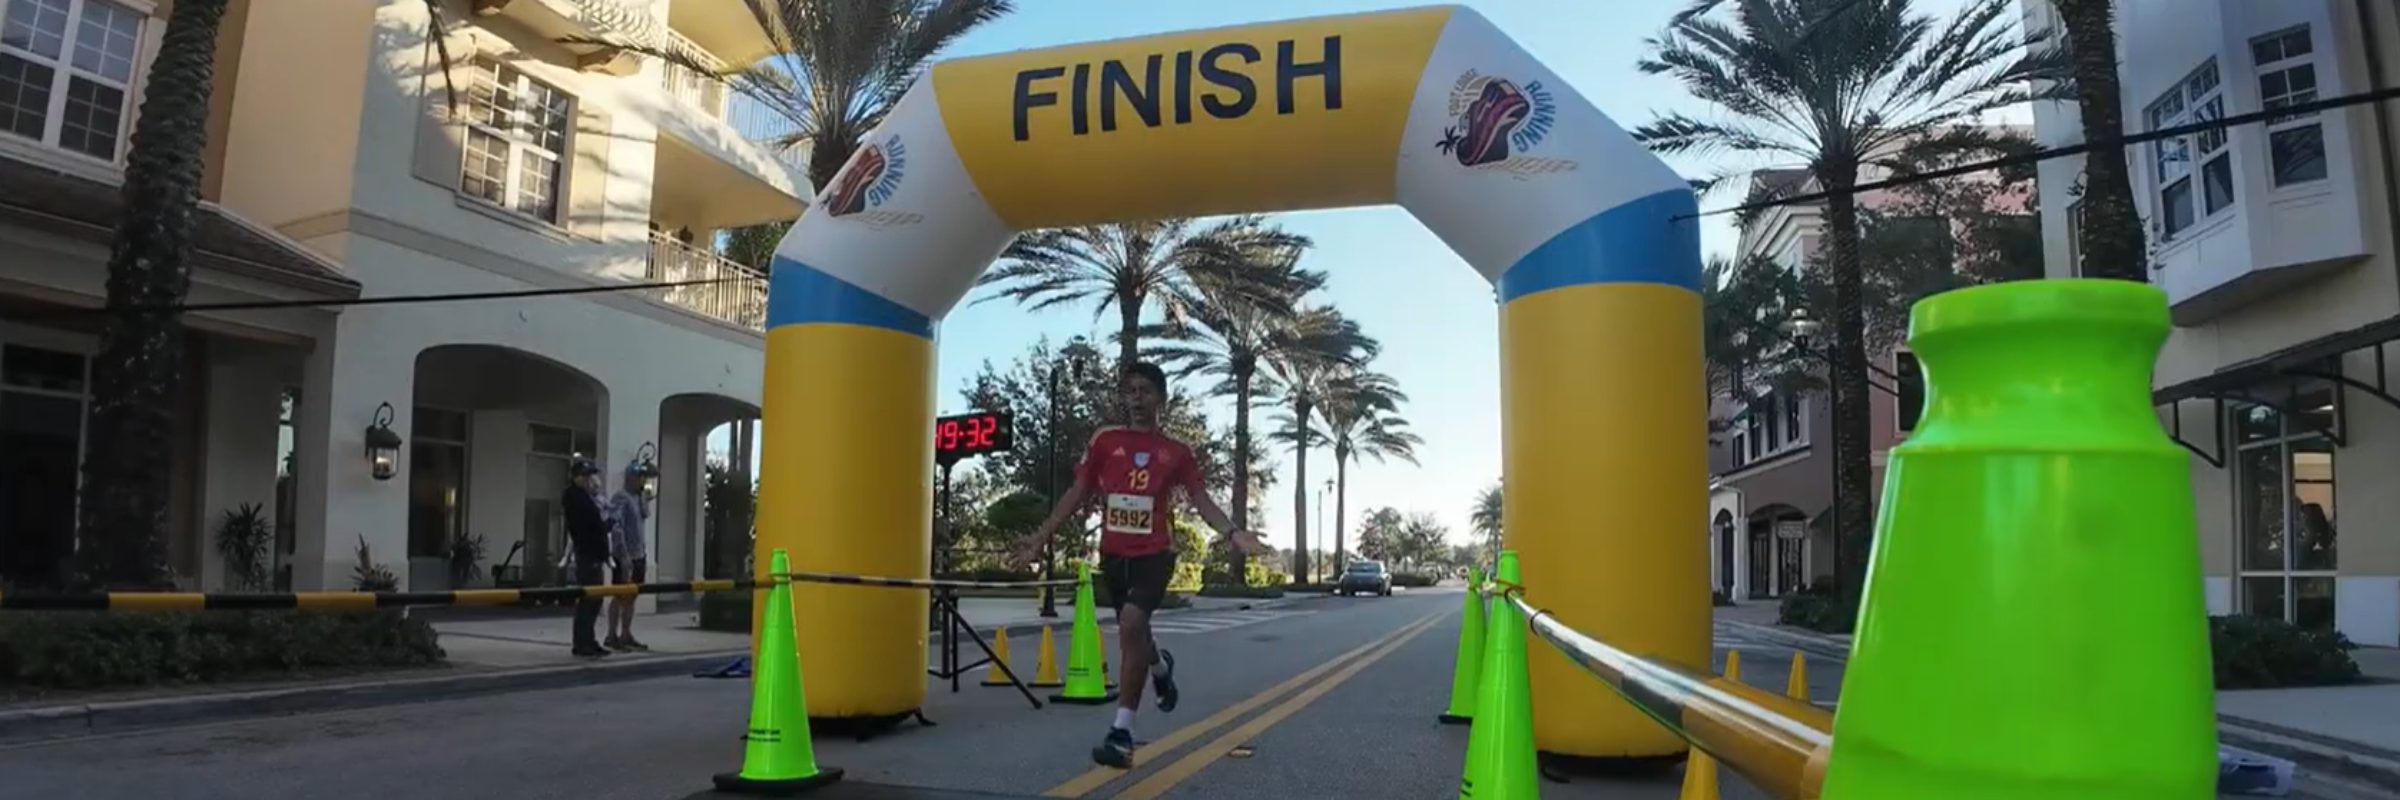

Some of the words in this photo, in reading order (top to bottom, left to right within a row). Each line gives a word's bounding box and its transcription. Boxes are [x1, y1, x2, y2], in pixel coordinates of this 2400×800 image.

[1012, 35, 1343, 142] FINISH
[1512, 80, 1556, 153] RUNNING
[868, 134, 905, 207] RUNNING
[1128, 468, 1150, 491] 19
[1108, 507, 1151, 528] 5992
